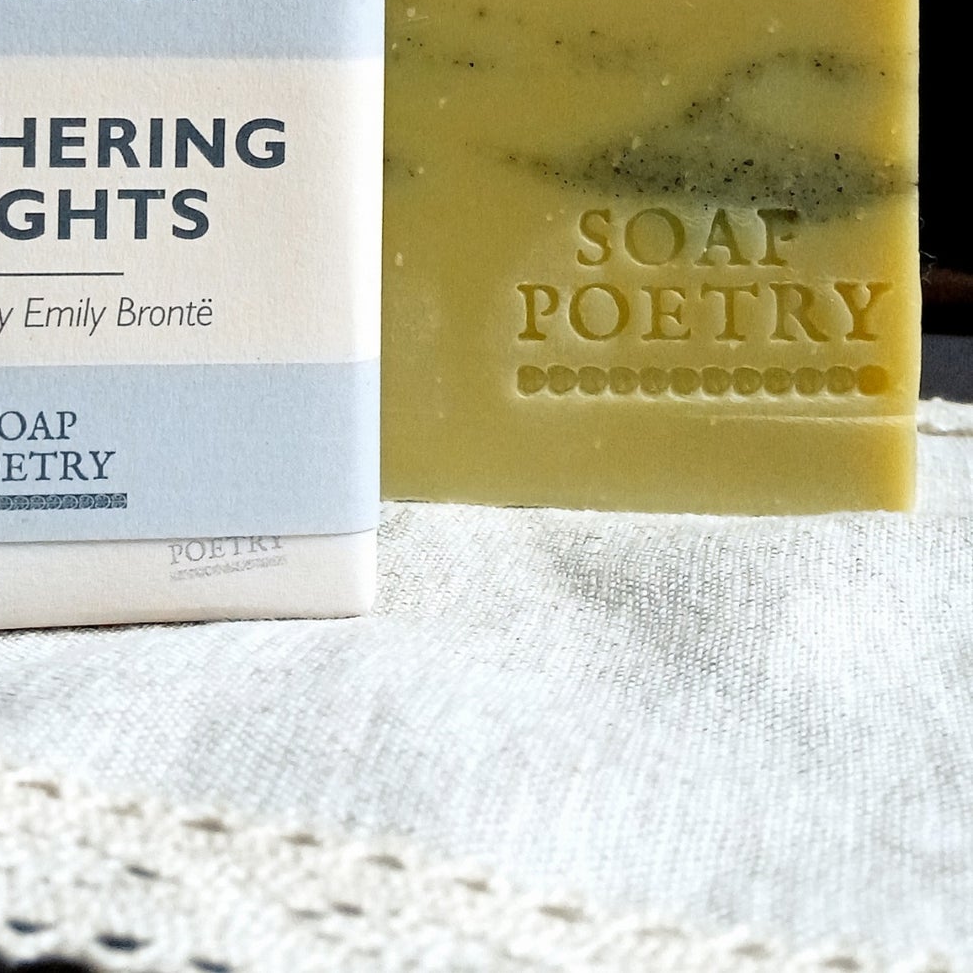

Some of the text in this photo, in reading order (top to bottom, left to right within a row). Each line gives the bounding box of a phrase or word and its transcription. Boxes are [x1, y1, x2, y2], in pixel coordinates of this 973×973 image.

[576, 206, 799, 267] SOAP
[24, 298, 108, 337] Emily
[117, 296, 213, 327] Brontë
[516, 282, 893, 343] POETRY
